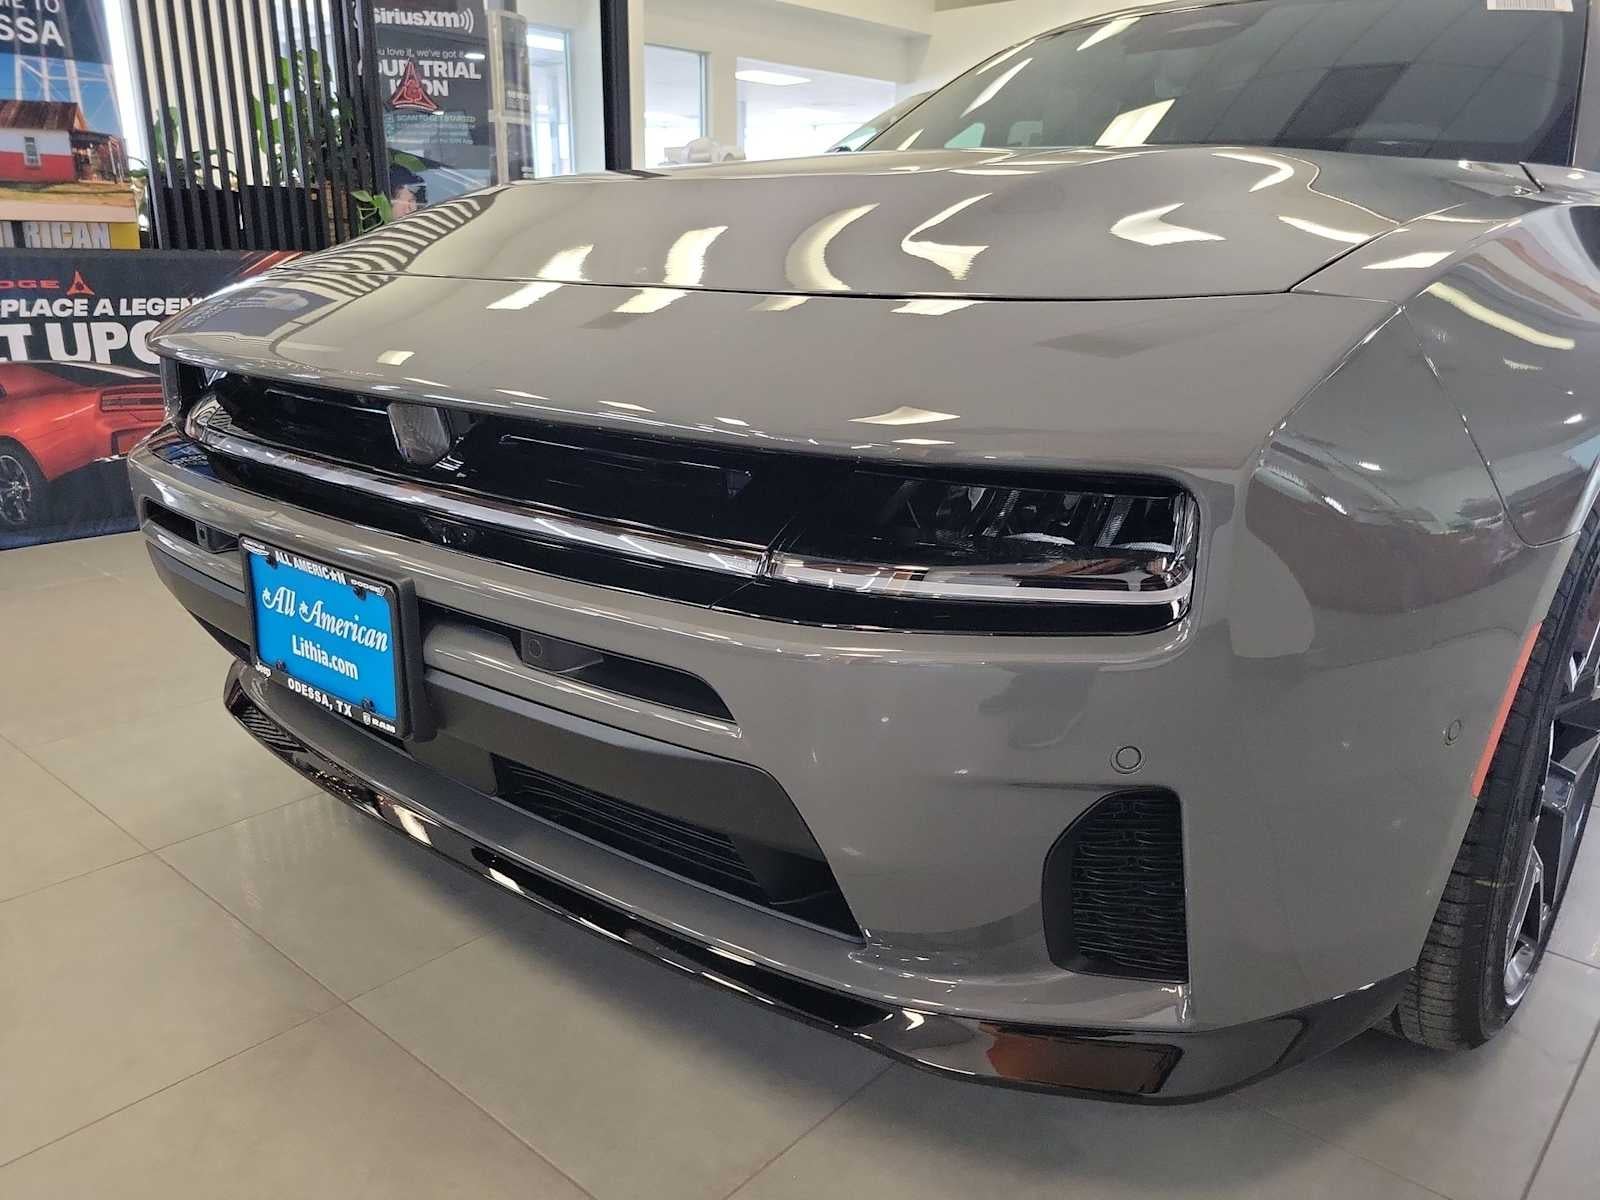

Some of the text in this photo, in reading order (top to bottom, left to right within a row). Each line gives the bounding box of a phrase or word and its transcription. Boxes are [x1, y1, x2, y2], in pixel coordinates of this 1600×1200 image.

[418, 60, 482, 80] TRIAL
[92, 297, 115, 317] A
[275, 550, 294, 567] ALL
[262, 586, 389, 653] All American
[291, 633, 360, 681] Lithia.com
[287, 677, 353, 718] ODESSA, TX
